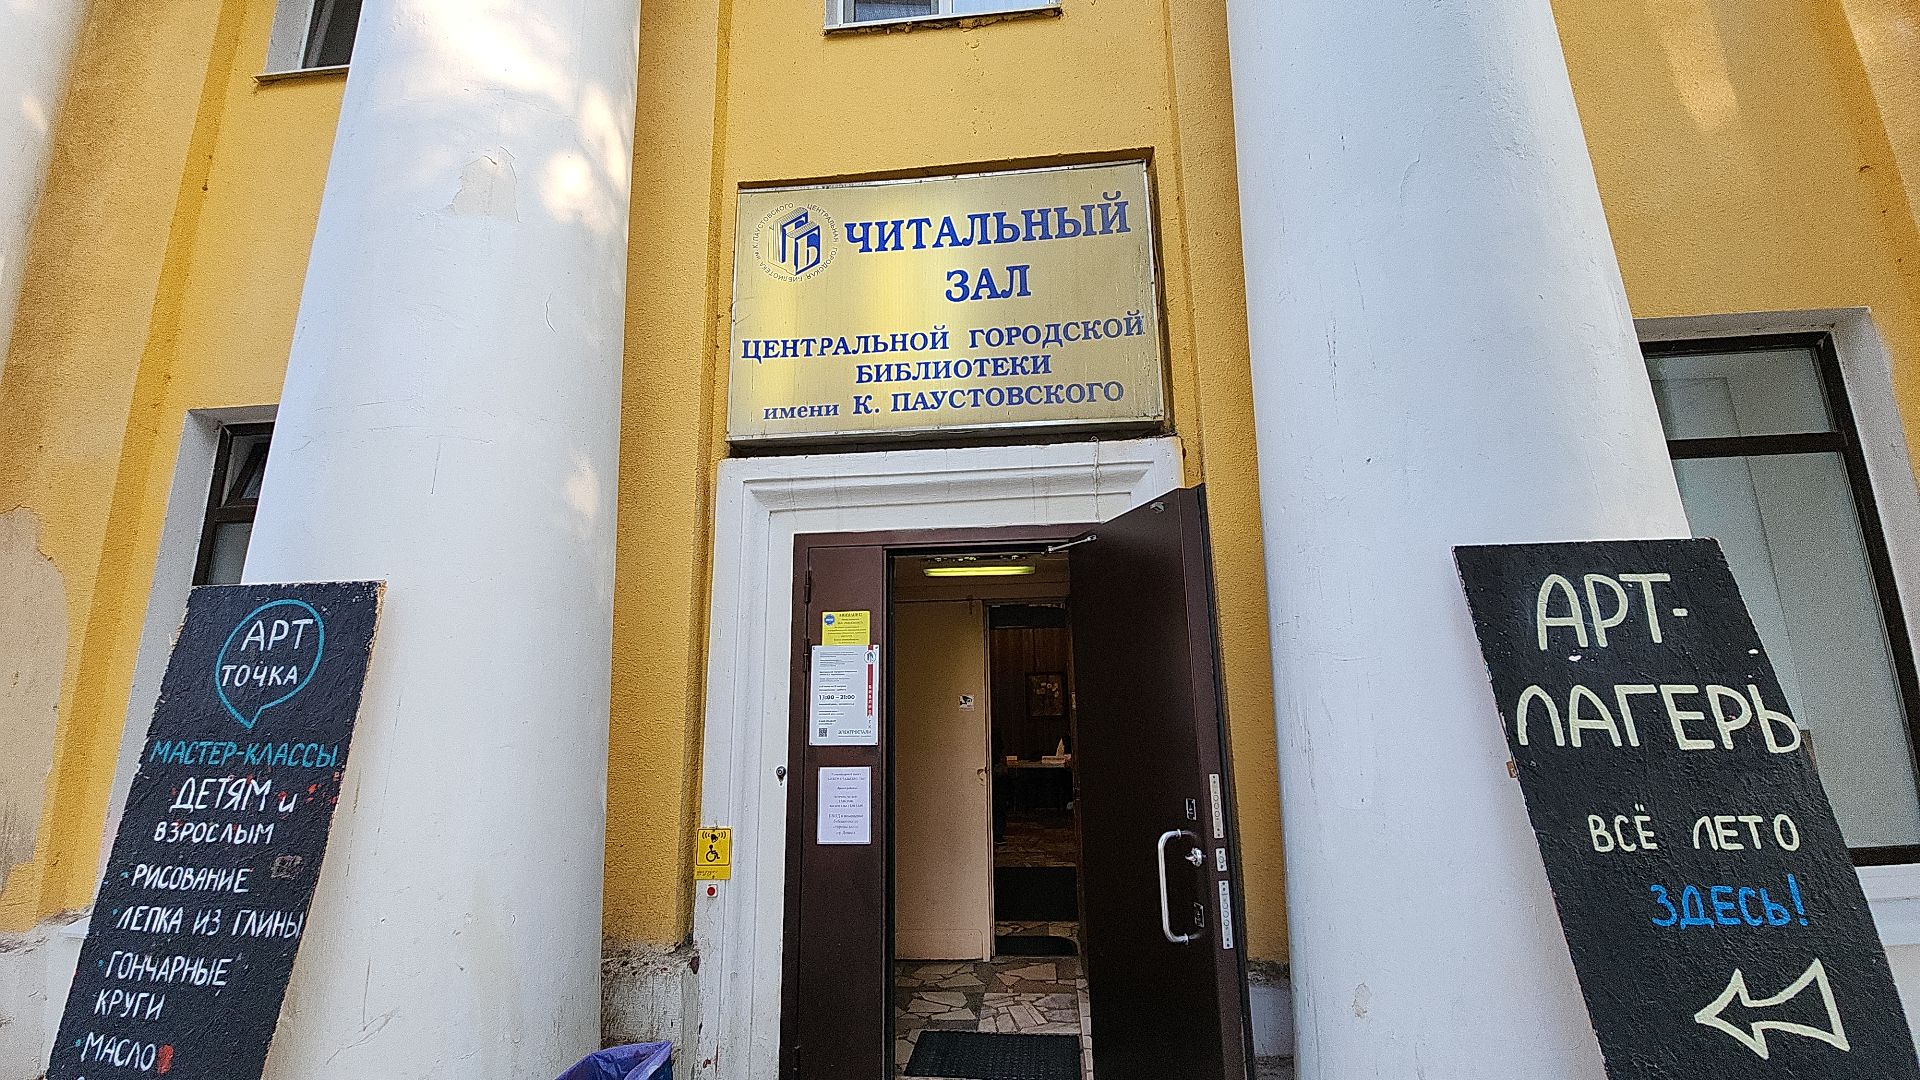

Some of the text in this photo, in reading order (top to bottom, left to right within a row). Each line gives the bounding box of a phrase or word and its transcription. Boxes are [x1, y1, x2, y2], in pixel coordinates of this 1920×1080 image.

[806, 203, 840, 243] ЦЕНТРАЛЬНАЯ
[844, 190, 1131, 254] ЧИТАЛЬНЫЙ
[805, 246, 839, 281] ГОРОДСКАЯ
[945, 264, 1032, 303] ЗАЛ
[741, 310, 1146, 363] ЦЕНТРАЛЬНОЙ ГОРОДСКОЙ
[856, 354, 1052, 384] БИБЛИОТЕКИ
[763, 381, 1124, 420] имени К. ПАУСТОВСКОГО
[1536, 572, 1688, 650] АРТ-
[241, 618, 314, 651] АРТ
[221, 664, 298, 687] ТОЧКА
[1516, 684, 1801, 755] ЛАГЕРЬ
[149, 739, 338, 768] МАСТЕР-КЛАССЫ
[170, 776, 298, 813] ДЕТЯМ и
[154, 821, 275, 844] ВЗРОСЛЫМ
[1588, 804, 1800, 853] ВСЁ ЛЕТО
[130, 864, 254, 893] РИСОВАНИЕ
[1649, 872, 1809, 930] ЗДЕСЬ!
[116, 906, 305, 939] ЛЕПКА ИЗ ГЛИНЫ
[105, 950, 235, 986] ГОНЧАРНЫЕ
[93, 988, 166, 1020] КРУГИ
[80, 1032, 156, 1072] МАСЛО
